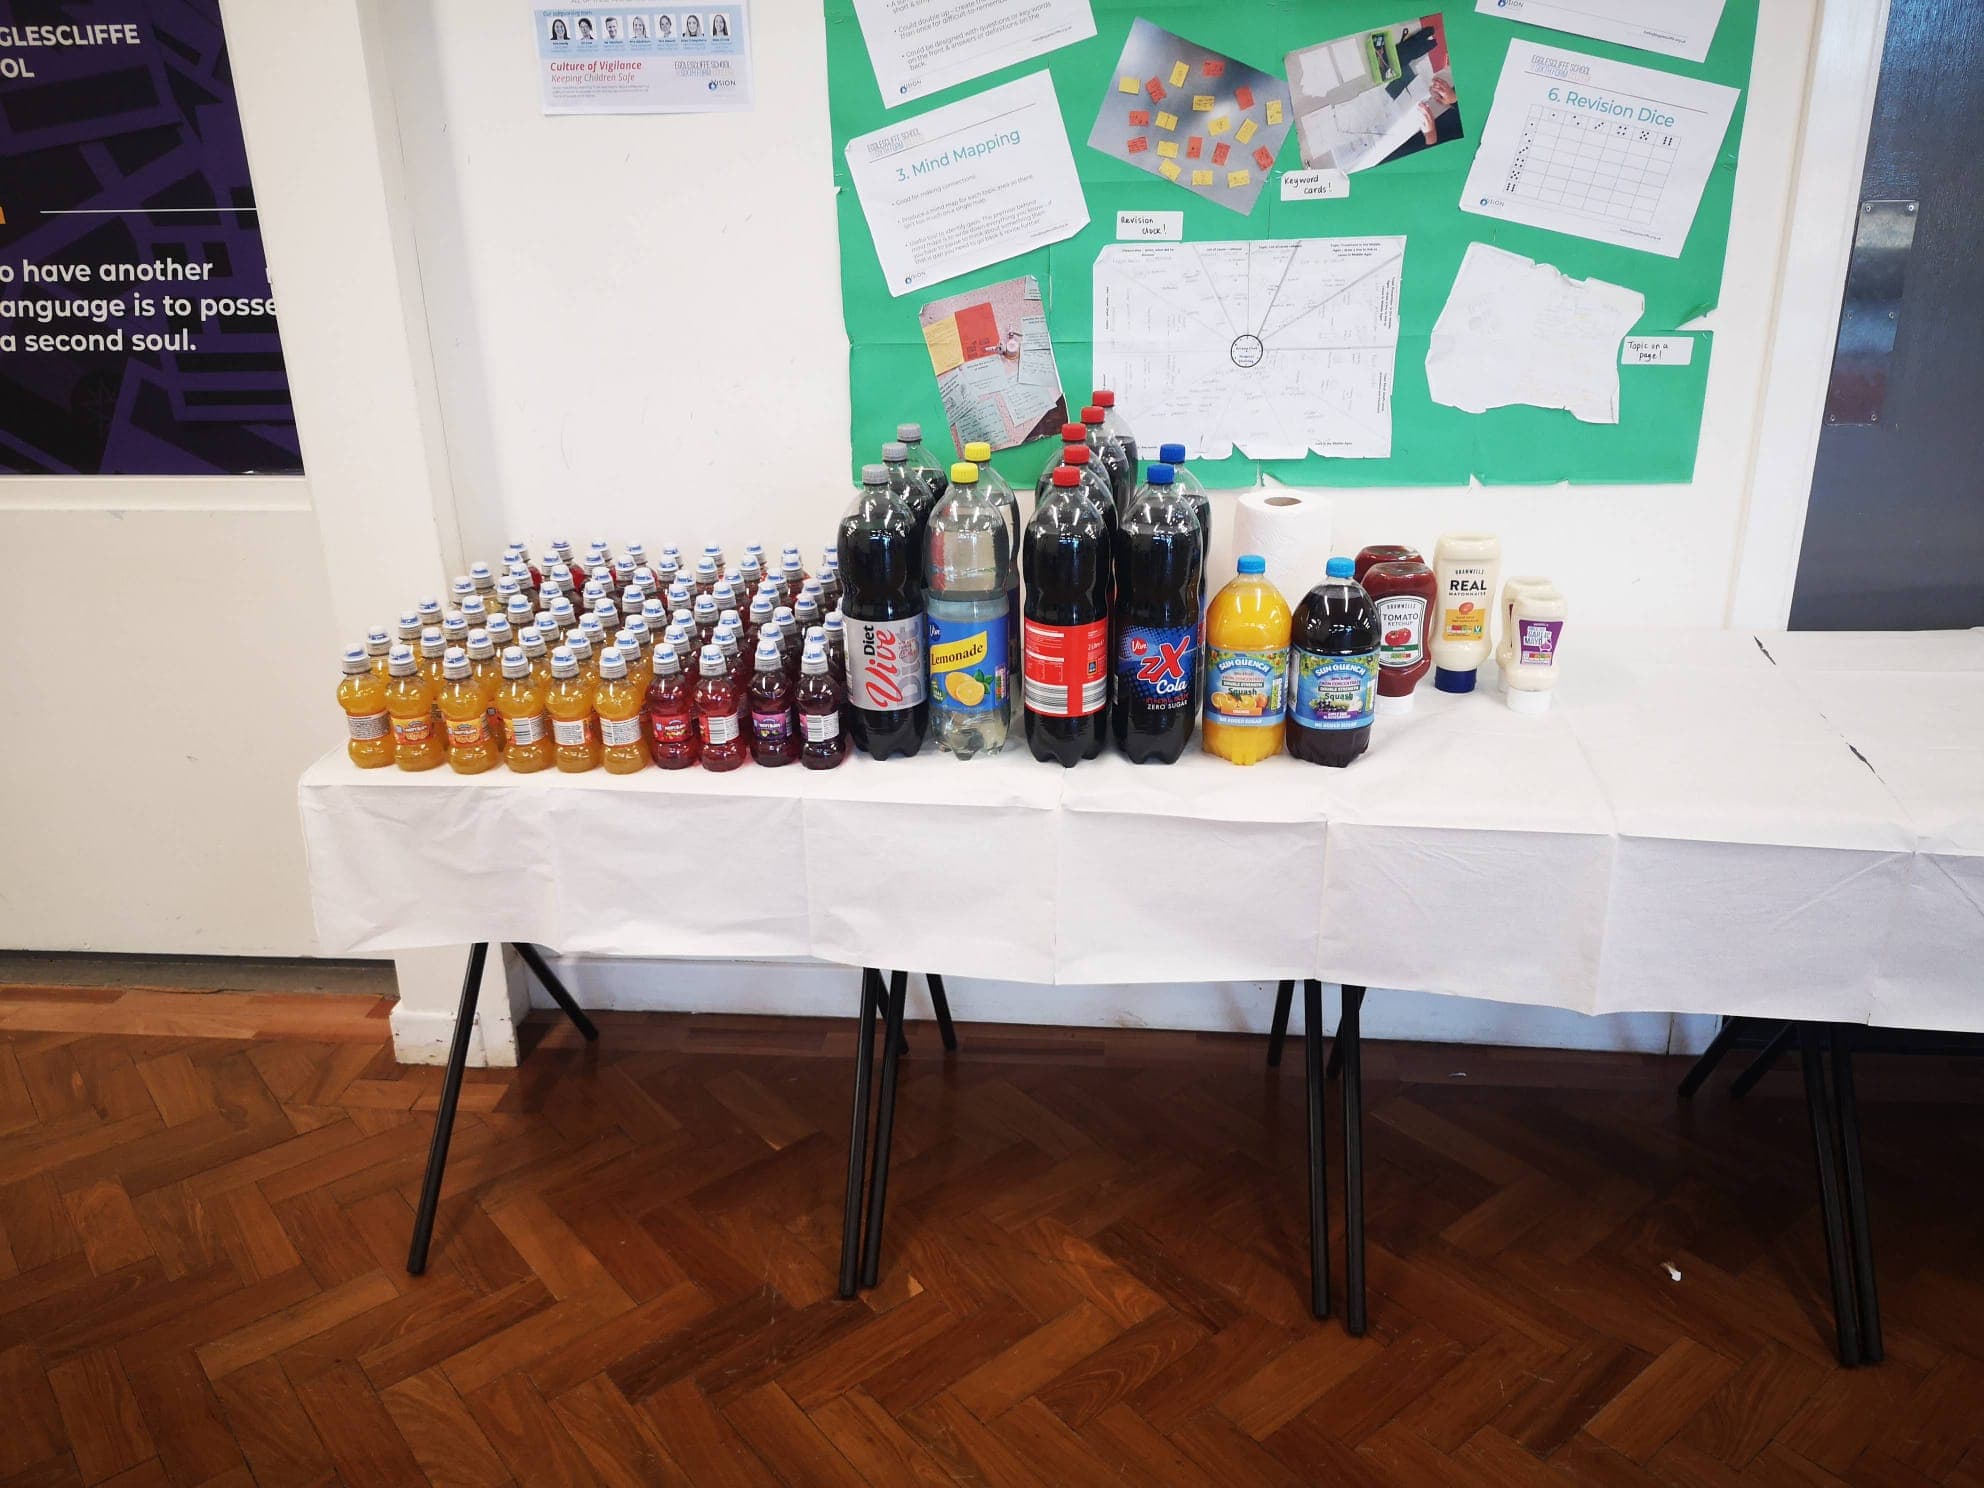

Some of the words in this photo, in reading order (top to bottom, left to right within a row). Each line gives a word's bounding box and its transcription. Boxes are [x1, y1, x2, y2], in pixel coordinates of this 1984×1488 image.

[550, 61, 584, 72] Culture
[587, 61, 597, 72] of
[600, 59, 641, 72] Vigilance
[551, 73, 581, 84] Keeping
[584, 72, 615, 82] Children
[618, 72, 635, 83] Safe
[1547, 87, 1562, 103] 6.
[1565, 90, 1634, 120] Revision
[1637, 106, 1675, 129] Dice
[895, 166, 910, 182] 3.
[911, 152, 950, 176] Mind
[951, 129, 1021, 164] Mapping
[1284, 174, 1319, 188] Keyword
[1120, 215, 1154, 224] Revision
[23, 259, 91, 282] have
[100, 258, 214, 282] another
[0, 299, 125, 323] anguage
[133, 292, 156, 316] is
[162, 294, 192, 317] to
[0, 335, 17, 352] a
[24, 328, 123, 352] second
[132, 328, 197, 351] soul.
[1627, 341, 1649, 351] Topic
[1449, 579, 1487, 591] REAL
[1383, 613, 1419, 621] TOMATO
[863, 624, 875, 656] Diet
[931, 644, 983, 666] Lemonade
[865, 629, 904, 708] Vive
[1218, 660, 1235, 671] SUN
[1235, 658, 1270, 673] QUENCH
[1315, 666, 1332, 677] SUN
[1332, 663, 1366, 676] QUENCH
[1156, 678, 1188, 694] Cola
[1228, 688, 1258, 697] Squash
[1324, 692, 1354, 701] Squash
[1167, 699, 1188, 709] SUGAR
